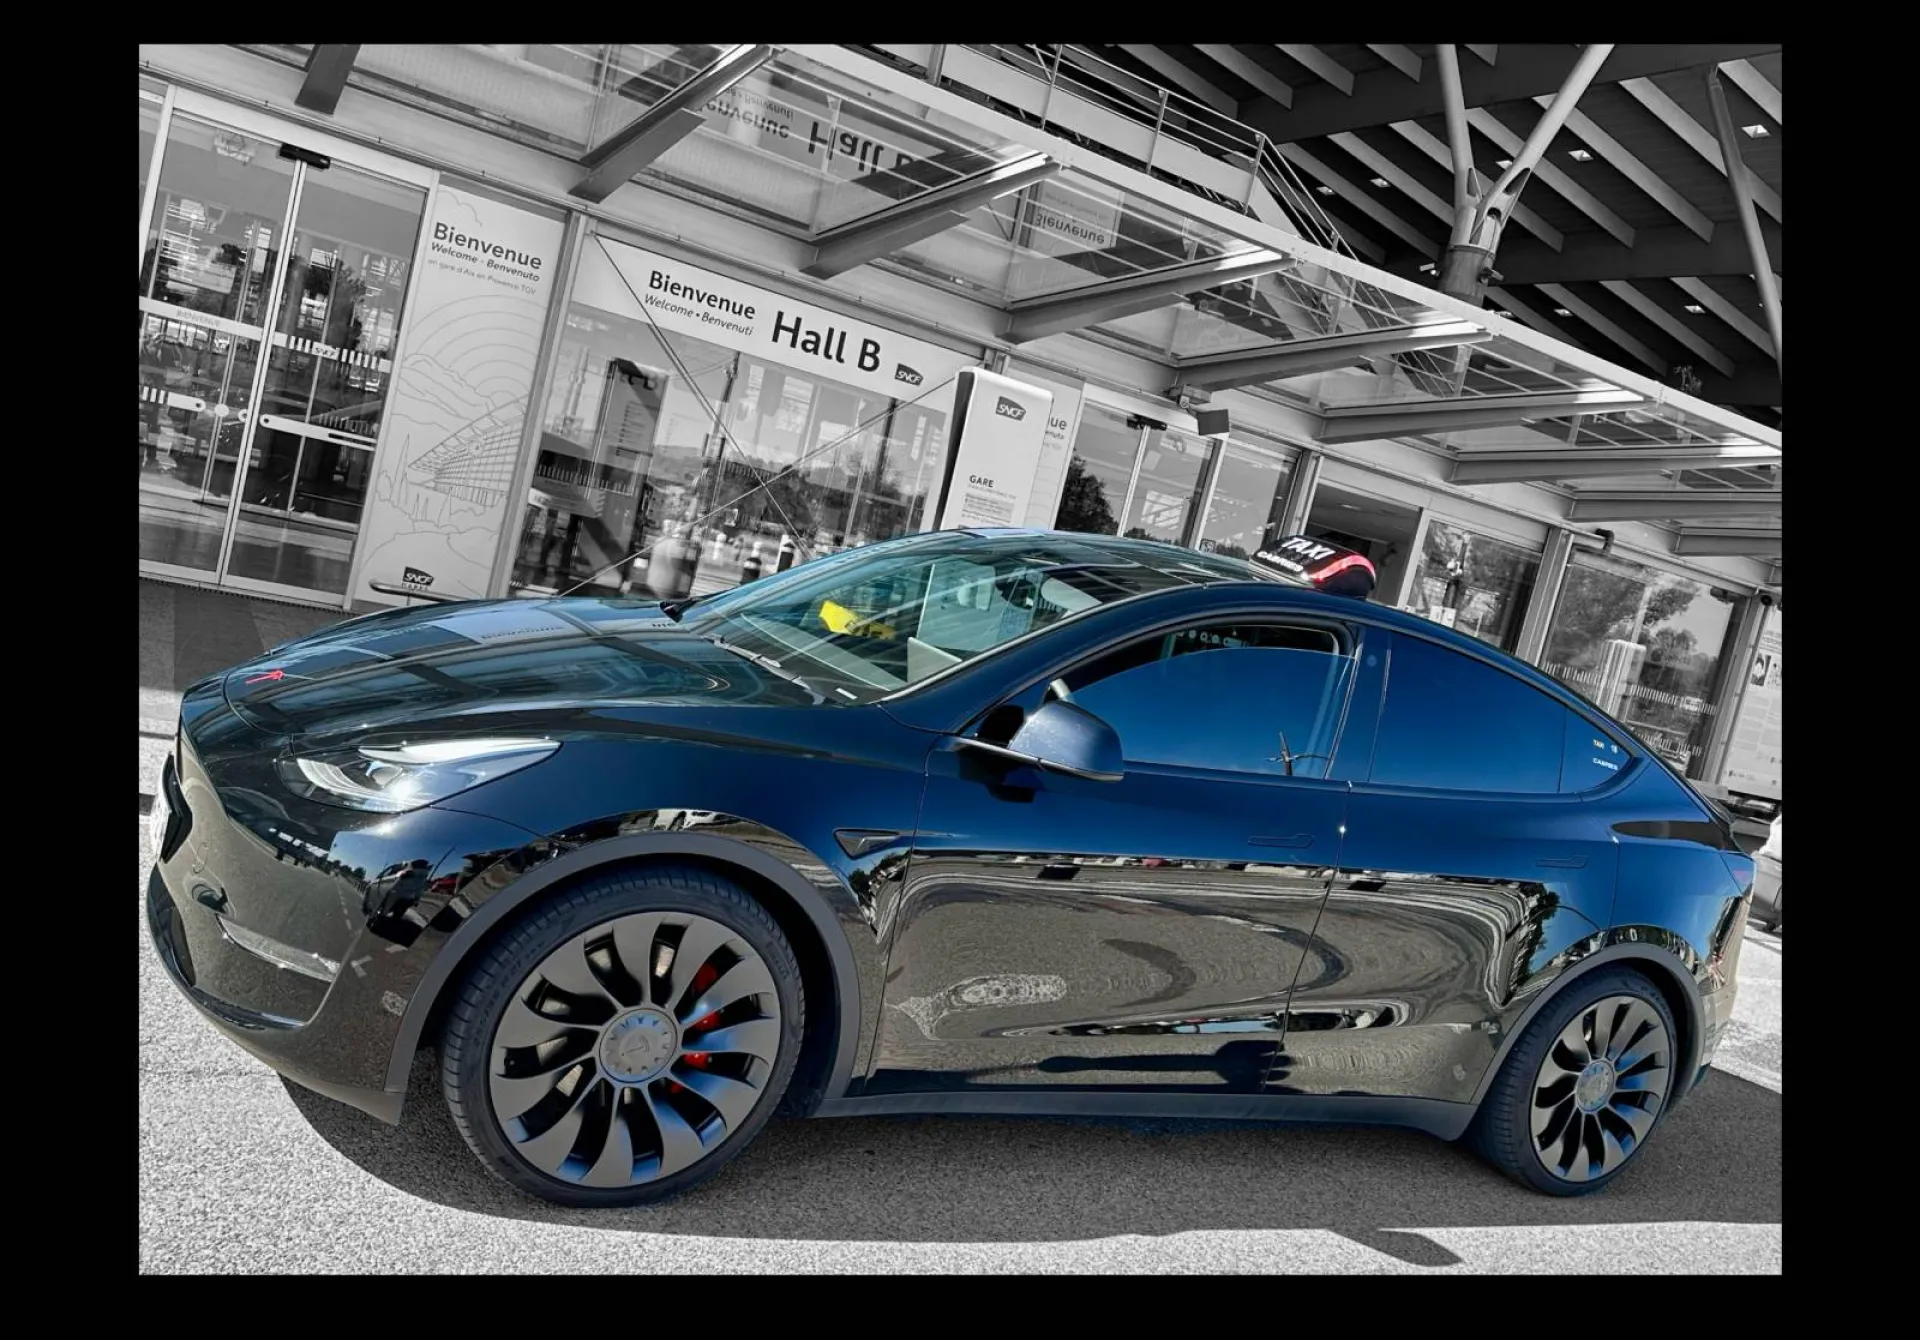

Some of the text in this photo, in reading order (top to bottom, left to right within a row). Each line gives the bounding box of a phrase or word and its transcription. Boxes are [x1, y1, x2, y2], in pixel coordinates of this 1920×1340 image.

[434, 222, 542, 270] Bienvenue
[431, 242, 540, 282] Welcome Benvenuto
[649, 270, 756, 319] Bienvenue
[644, 294, 754, 336] Welcome Benvenuti
[771, 310, 881, 372] Hall B
[896, 368, 922, 385] SNCF
[998, 402, 1024, 419] SNCF
[969, 474, 995, 488] GARE
[1281, 537, 1336, 560] TAXI
[404, 570, 433, 585] SNCF
